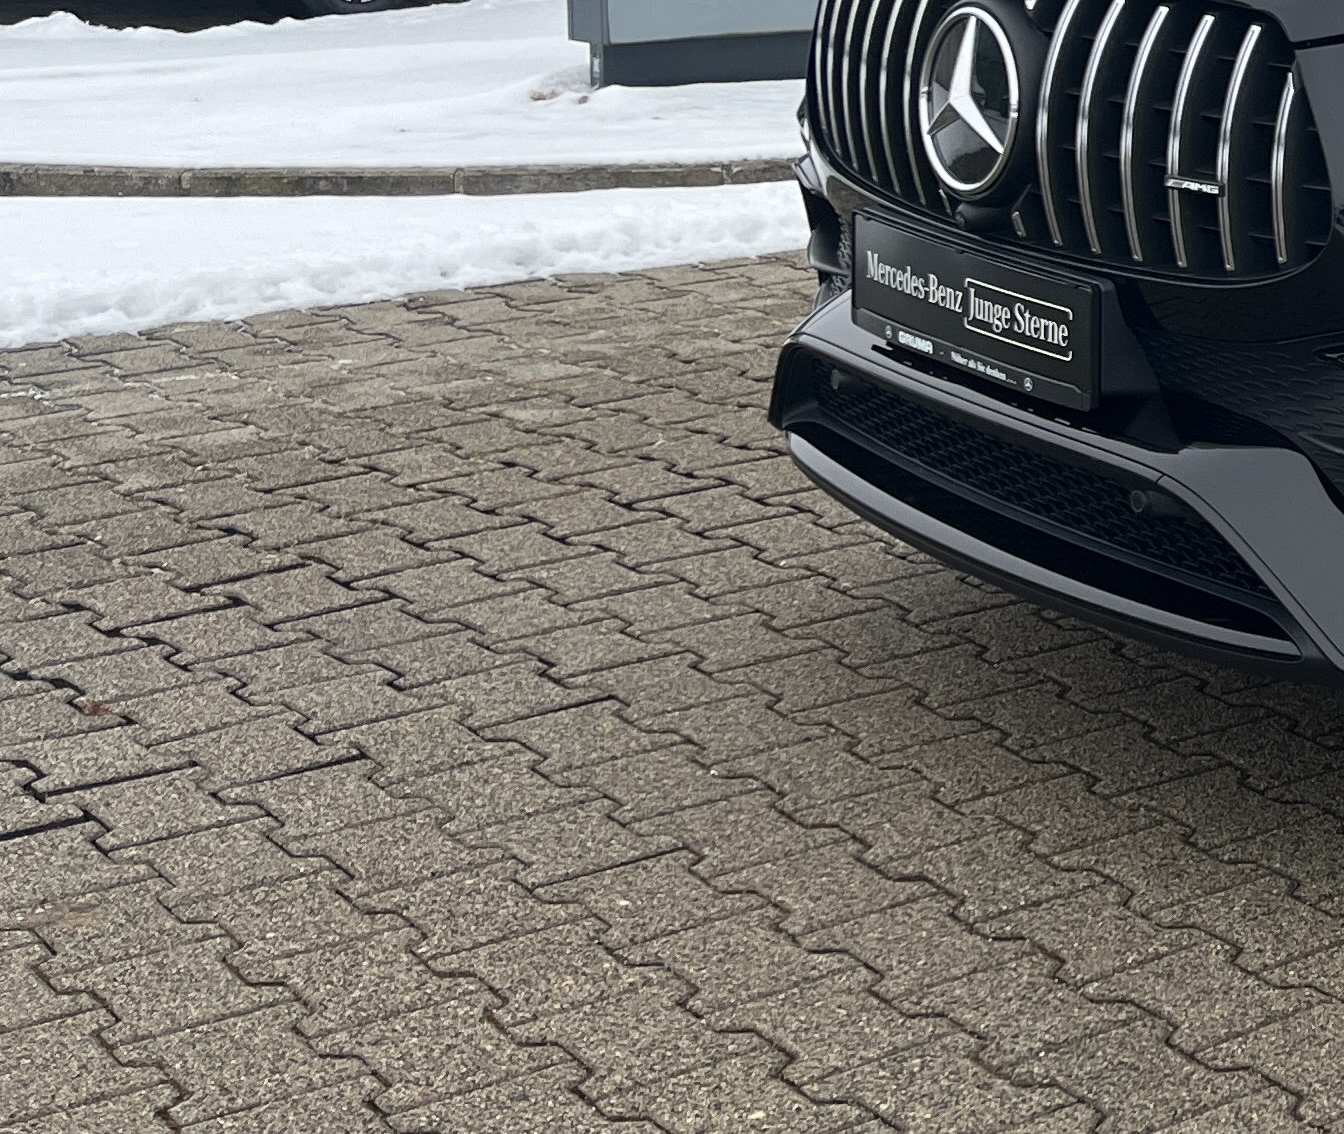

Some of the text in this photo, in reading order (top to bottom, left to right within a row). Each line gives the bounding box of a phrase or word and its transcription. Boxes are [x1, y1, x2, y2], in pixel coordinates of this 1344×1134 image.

[1182, 180, 1219, 195] AMG
[866, 250, 1069, 347] Mercedes-Benz Junge Sterne
